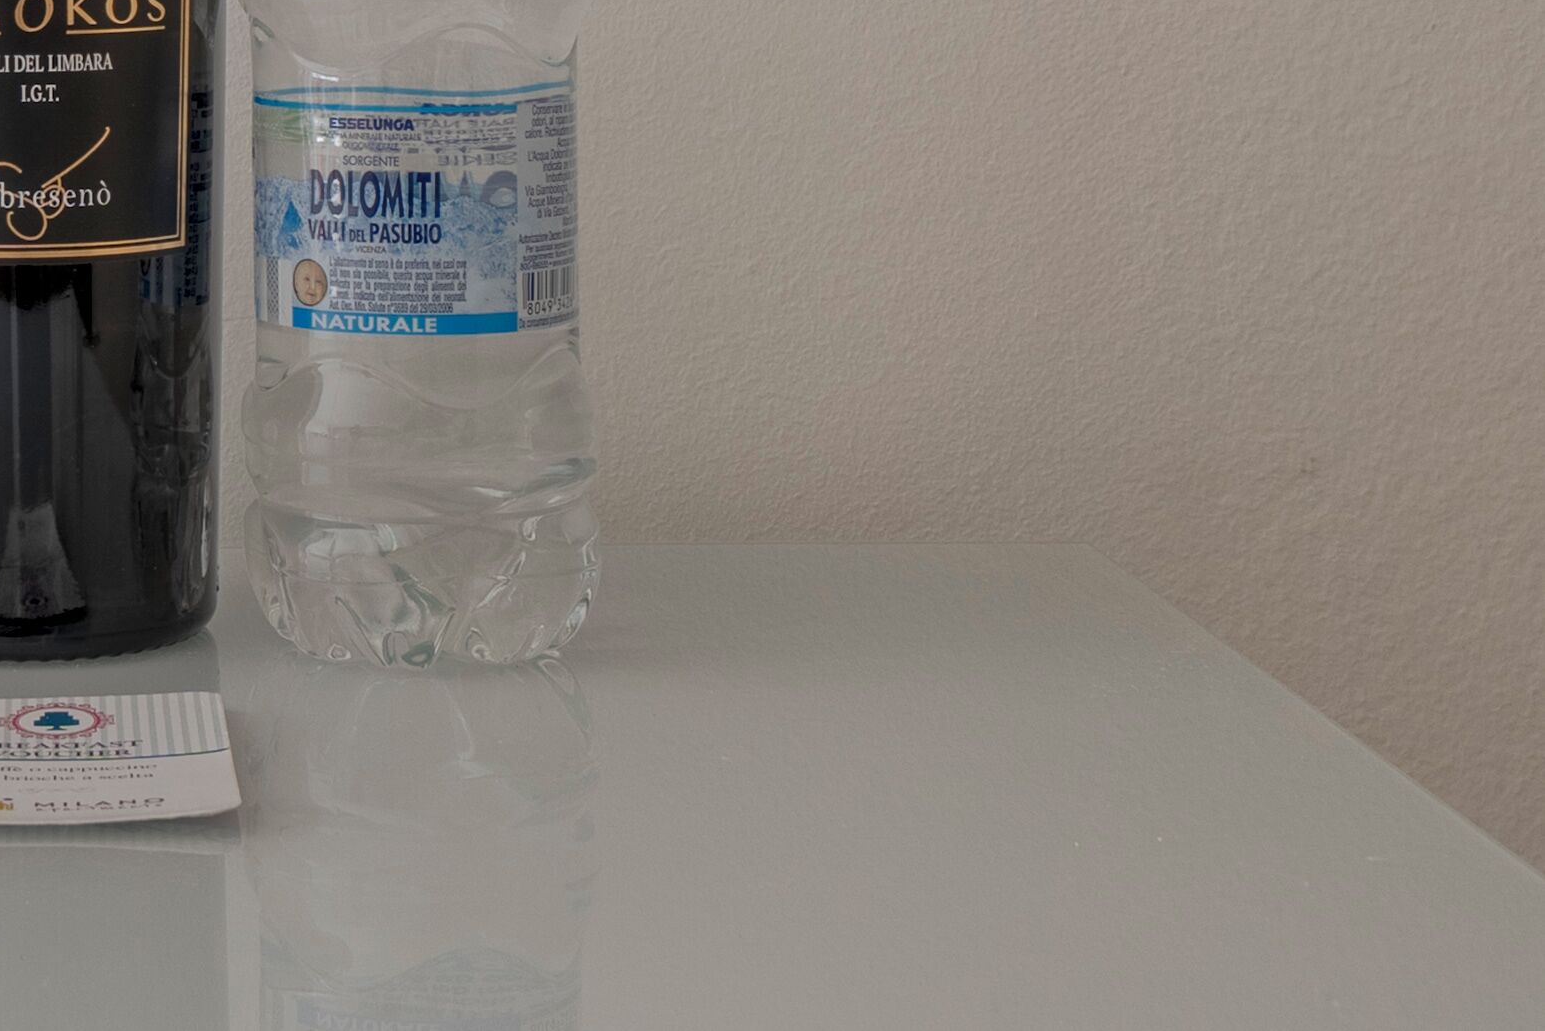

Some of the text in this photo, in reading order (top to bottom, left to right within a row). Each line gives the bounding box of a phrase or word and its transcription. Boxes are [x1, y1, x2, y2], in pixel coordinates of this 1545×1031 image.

[13, 54, 45, 73] DEL
[47, 53, 114, 72] LIMBARA
[21, 84, 60, 103] I.G.T.
[329, 117, 414, 132] ESSELUNGA
[342, 155, 400, 168] SORGENTE
[310, 169, 441, 219] DOLOMITI
[349, 228, 367, 243] DEL
[369, 222, 442, 244] PASUBIO
[355, 245, 388, 255] VICENZA
[310, 313, 438, 334] NATURALE
[34, 796, 165, 808] MILANO
